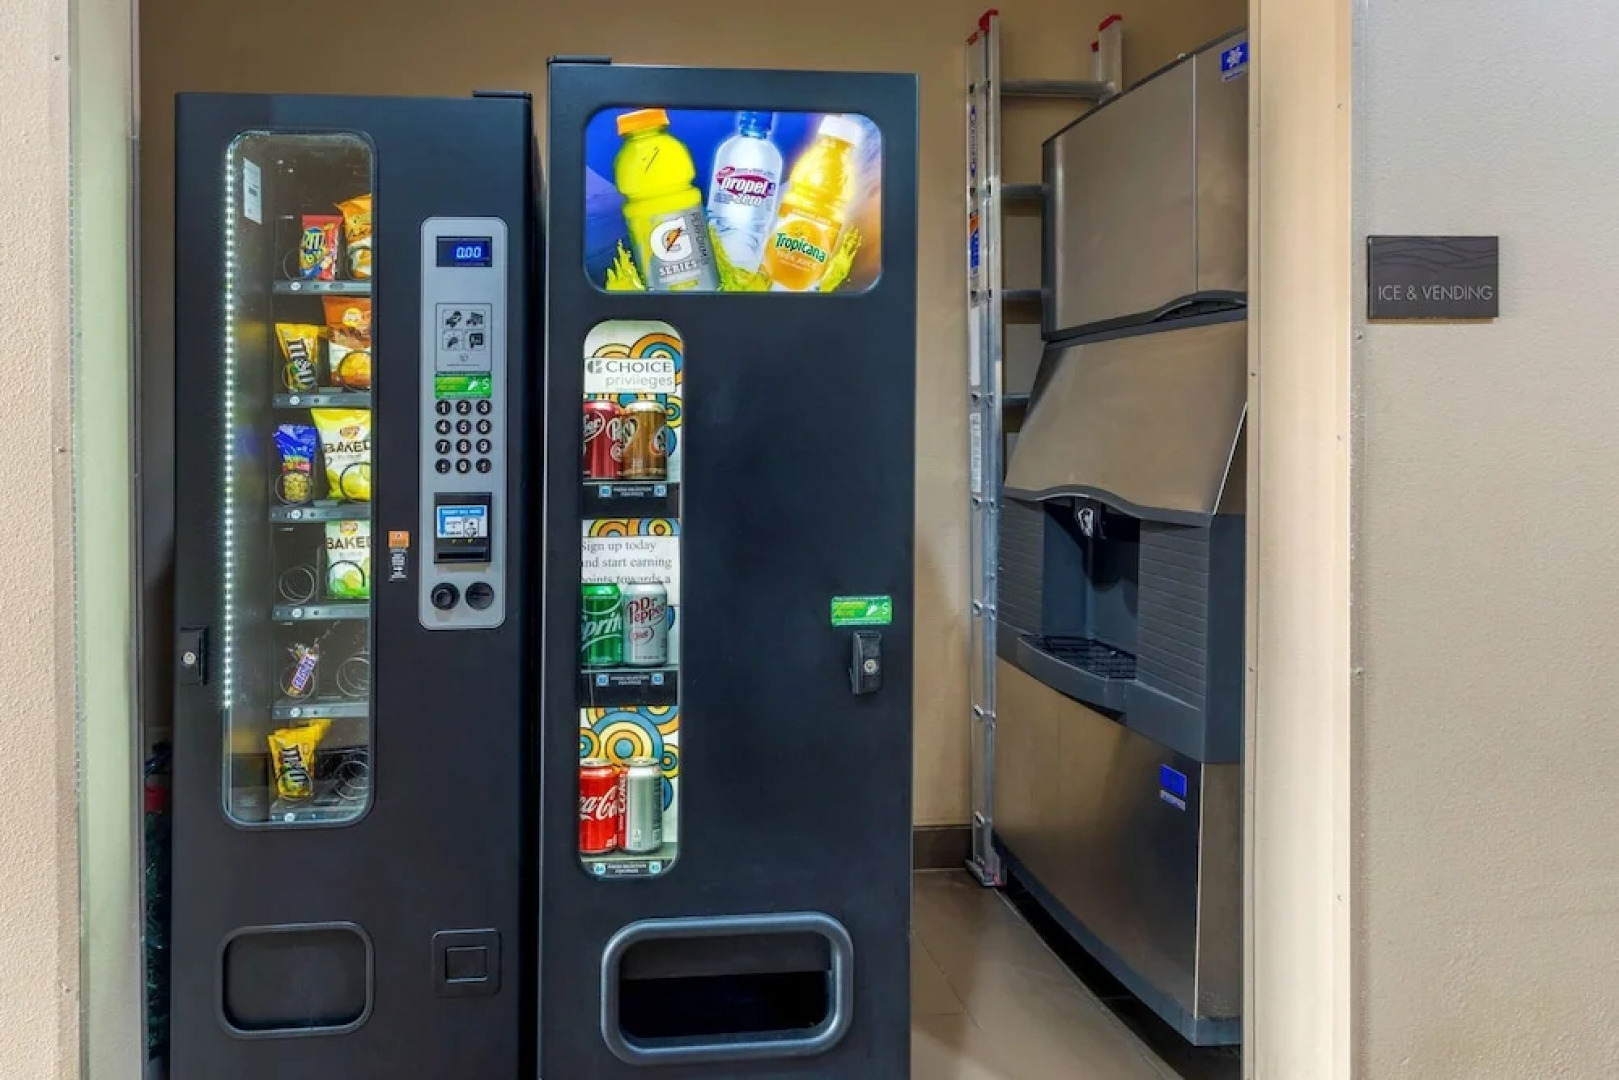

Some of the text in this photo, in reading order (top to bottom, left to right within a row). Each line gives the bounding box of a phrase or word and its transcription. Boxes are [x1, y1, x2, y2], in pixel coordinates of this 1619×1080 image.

[775, 232, 827, 263] Tropicana
[659, 259, 697, 276] SERIES
[1378, 284, 1494, 301] ICE & VENDING
[605, 360, 673, 374] CHOICE
[605, 374, 673, 389] privileges
[608, 543, 623, 552] up
[625, 540, 656, 552] today
[601, 558, 628, 568] start
[630, 556, 673, 570] earning
